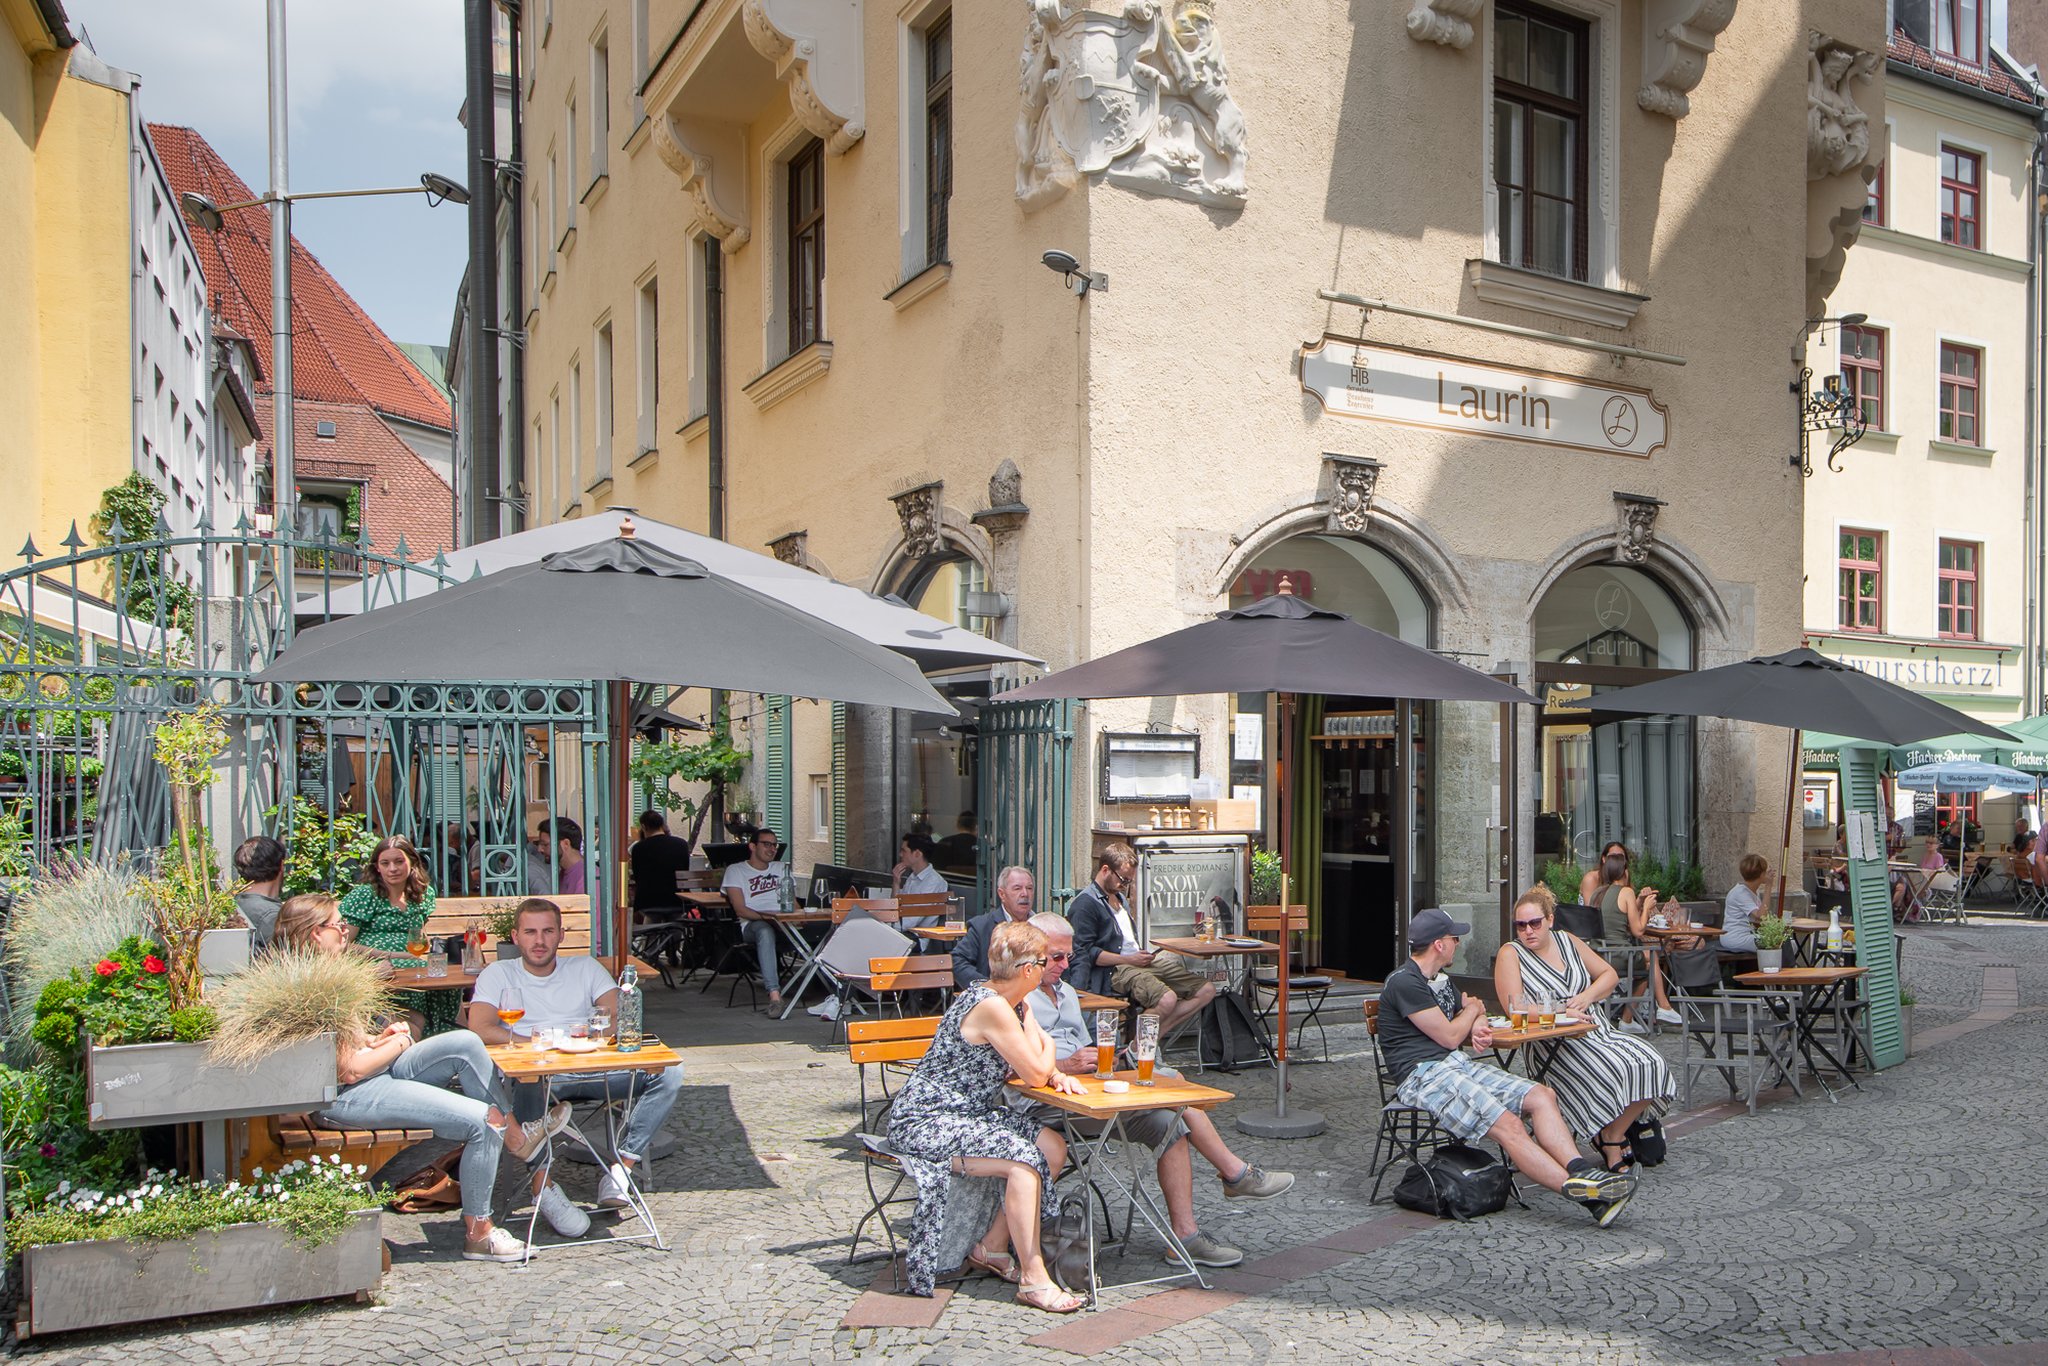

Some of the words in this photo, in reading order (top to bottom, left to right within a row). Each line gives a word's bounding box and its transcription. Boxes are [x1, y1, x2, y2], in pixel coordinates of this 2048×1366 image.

[1829, 378, 1839, 392] H
[1438, 371, 1550, 430] Laurin
[1586, 633, 1640, 657] Laurin
[1838, 653, 2002, 687] twurstherzl
[1906, 749, 1982, 767] Hacker-Pschorr
[1947, 775, 1989, 784] Hacker-Pschorr
[1153, 864, 1185, 873] FREDRIK
[1187, 863, 1229, 873] RYDMAN'S
[1153, 875, 1201, 892] SNOW
[1150, 890, 1206, 909] WHITE
